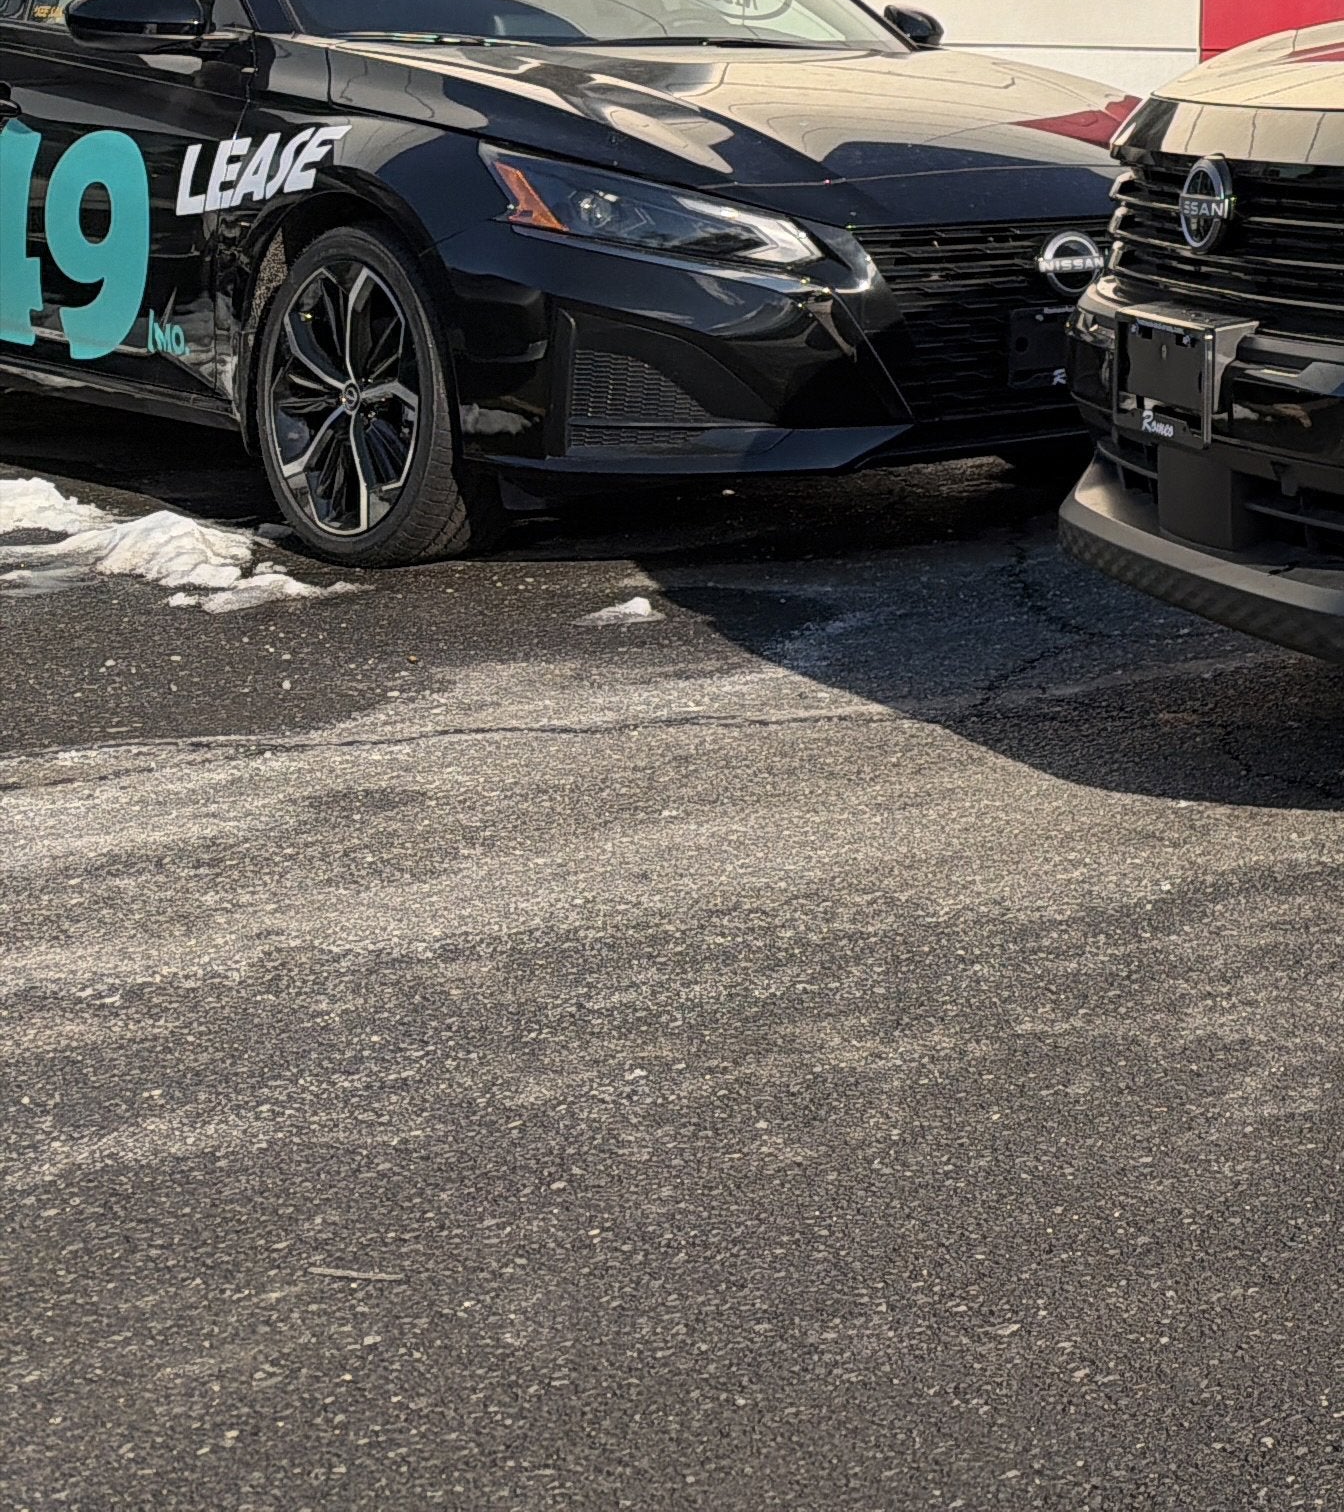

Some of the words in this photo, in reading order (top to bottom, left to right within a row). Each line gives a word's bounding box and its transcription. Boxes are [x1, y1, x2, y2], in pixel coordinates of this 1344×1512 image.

[175, 125, 352, 216] LEASE
[1040, 256, 1104, 272] NISSAN
[1141, 410, 1174, 437] Romeo
